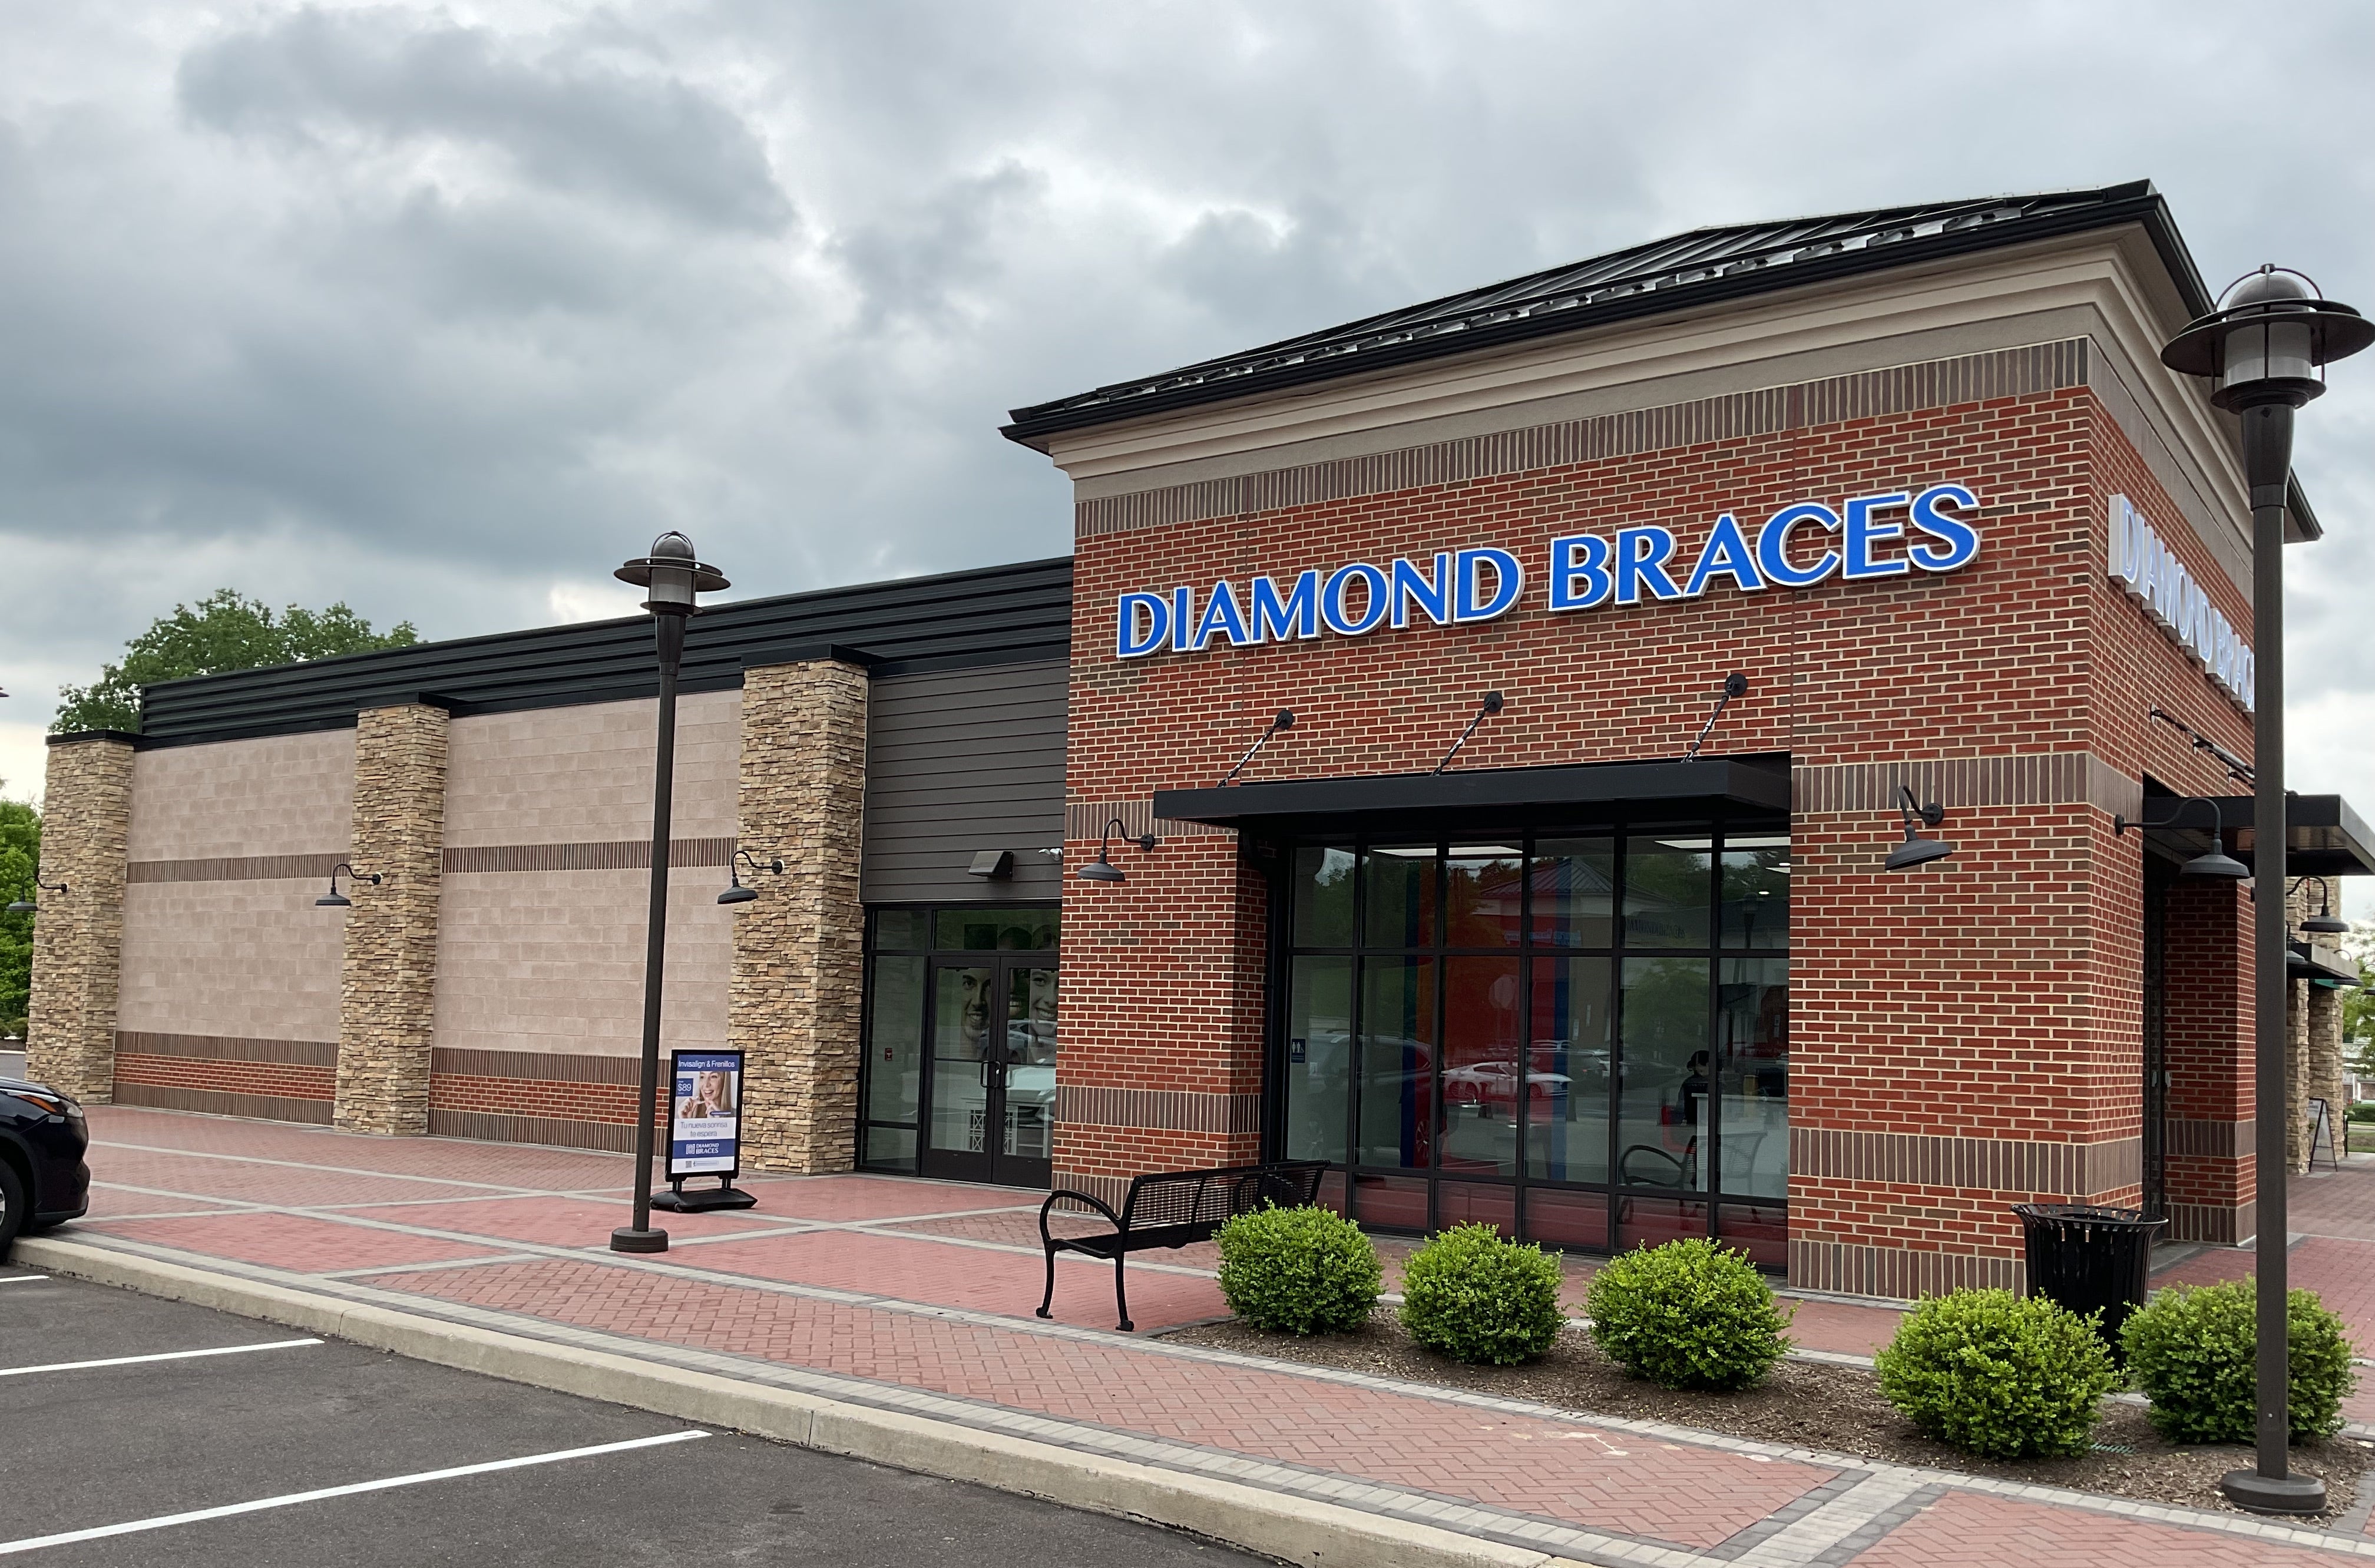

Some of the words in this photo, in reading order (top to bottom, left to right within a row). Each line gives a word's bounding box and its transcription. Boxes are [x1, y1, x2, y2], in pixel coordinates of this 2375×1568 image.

[1116, 545, 1523, 660] DIAMOND
[1548, 482, 1981, 613] BRACES
[2109, 493, 2214, 664] DIAMOND
[2205, 607, 2255, 713] BRAC
[677, 1083, 692, 1091] $89
[678, 1060, 705, 1069] Invisalign
